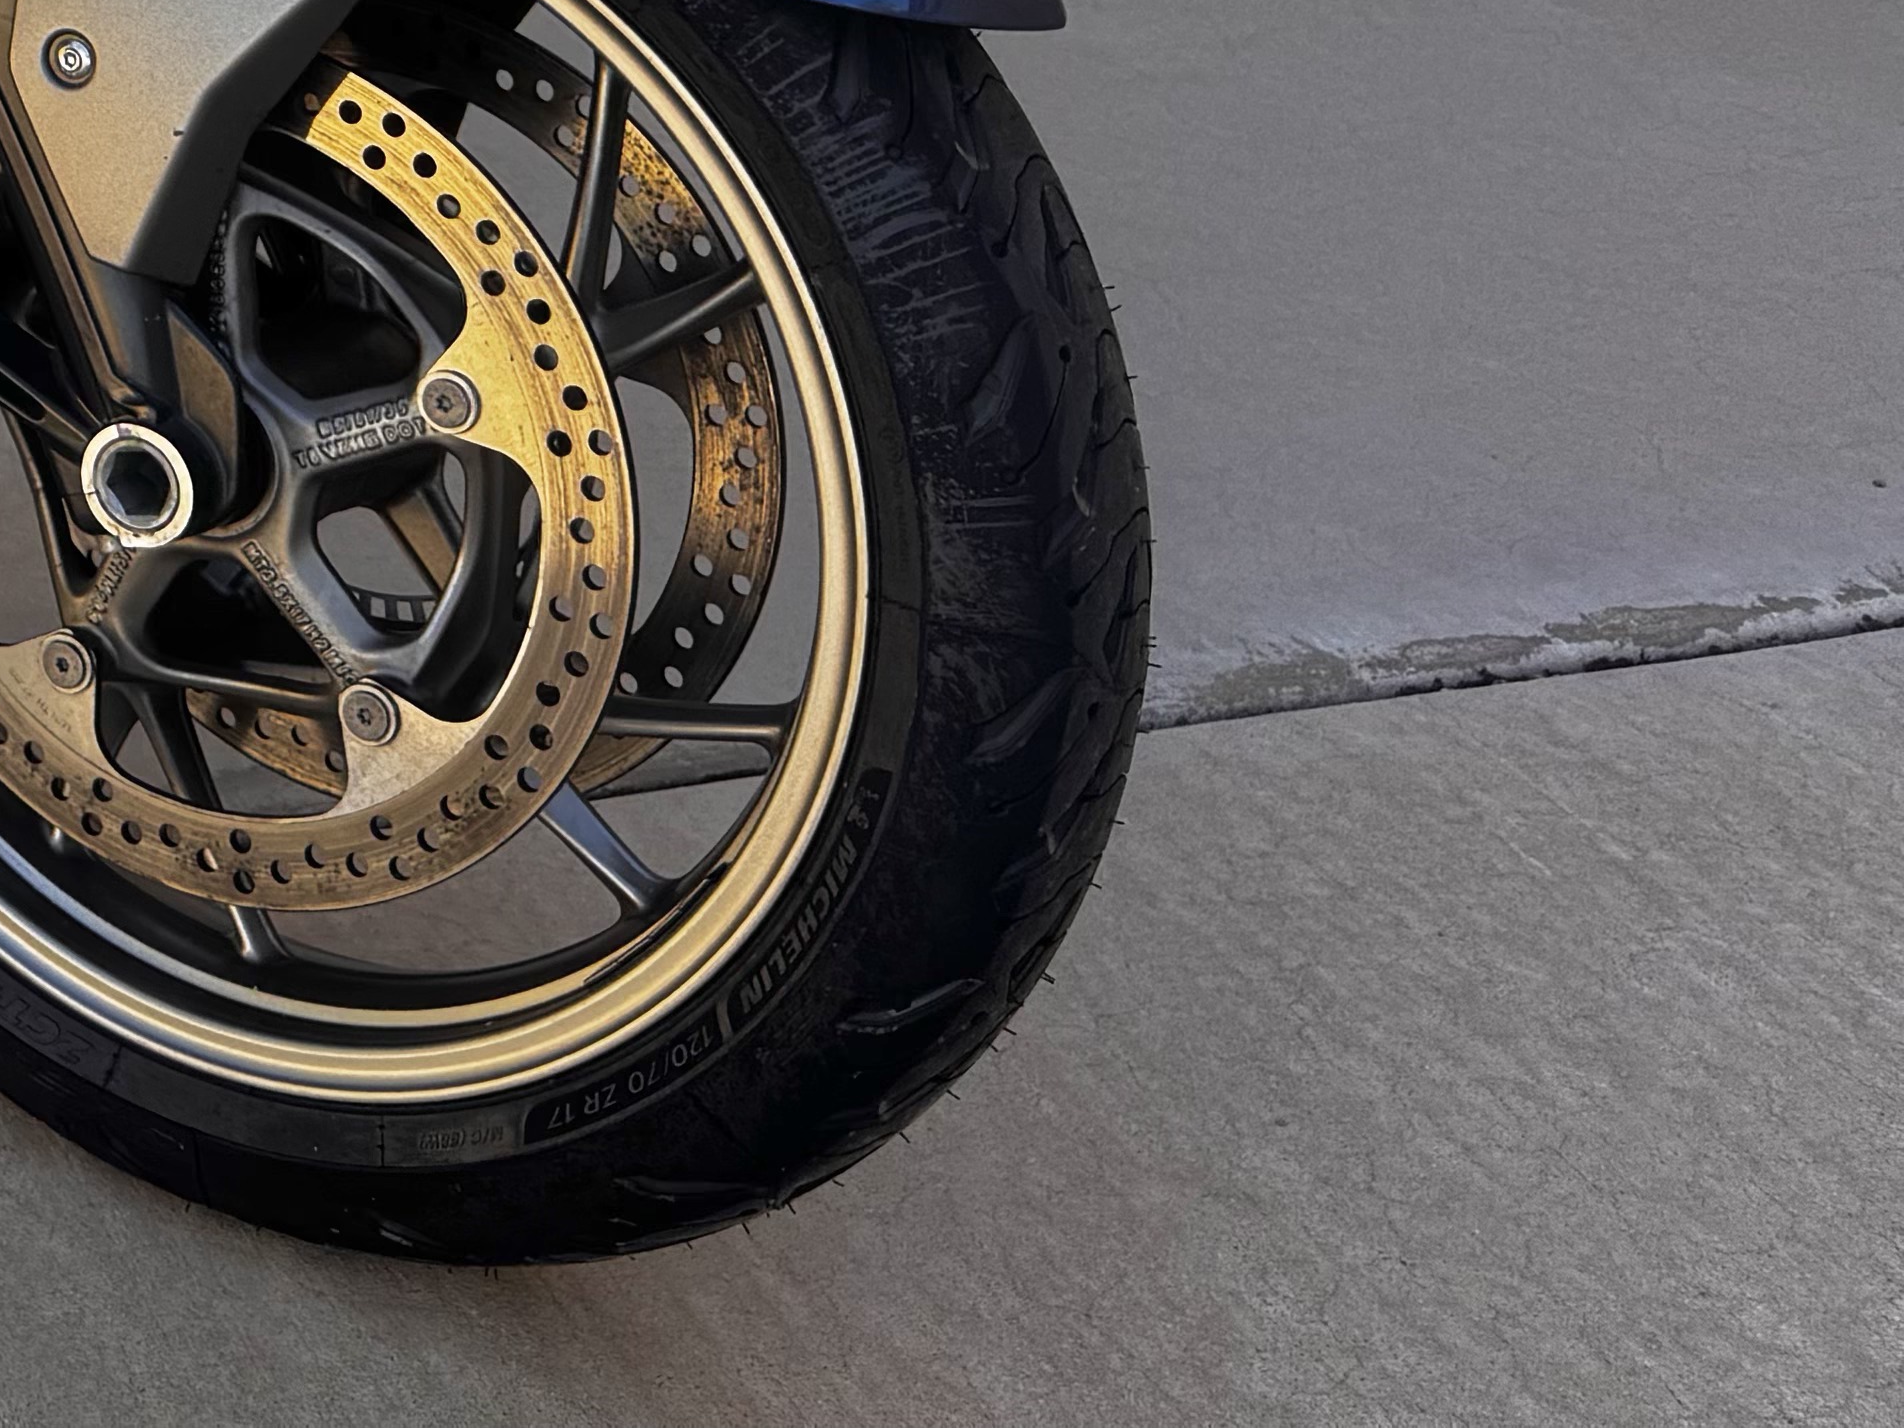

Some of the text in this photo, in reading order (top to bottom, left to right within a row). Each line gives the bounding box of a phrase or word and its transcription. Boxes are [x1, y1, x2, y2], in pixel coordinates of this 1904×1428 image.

[739, 833, 858, 1014] MICHELIN
[628, 1025, 715, 1094] 120/70
[547, 1102, 576, 1130] 17
[583, 1083, 617, 1115] ZR
